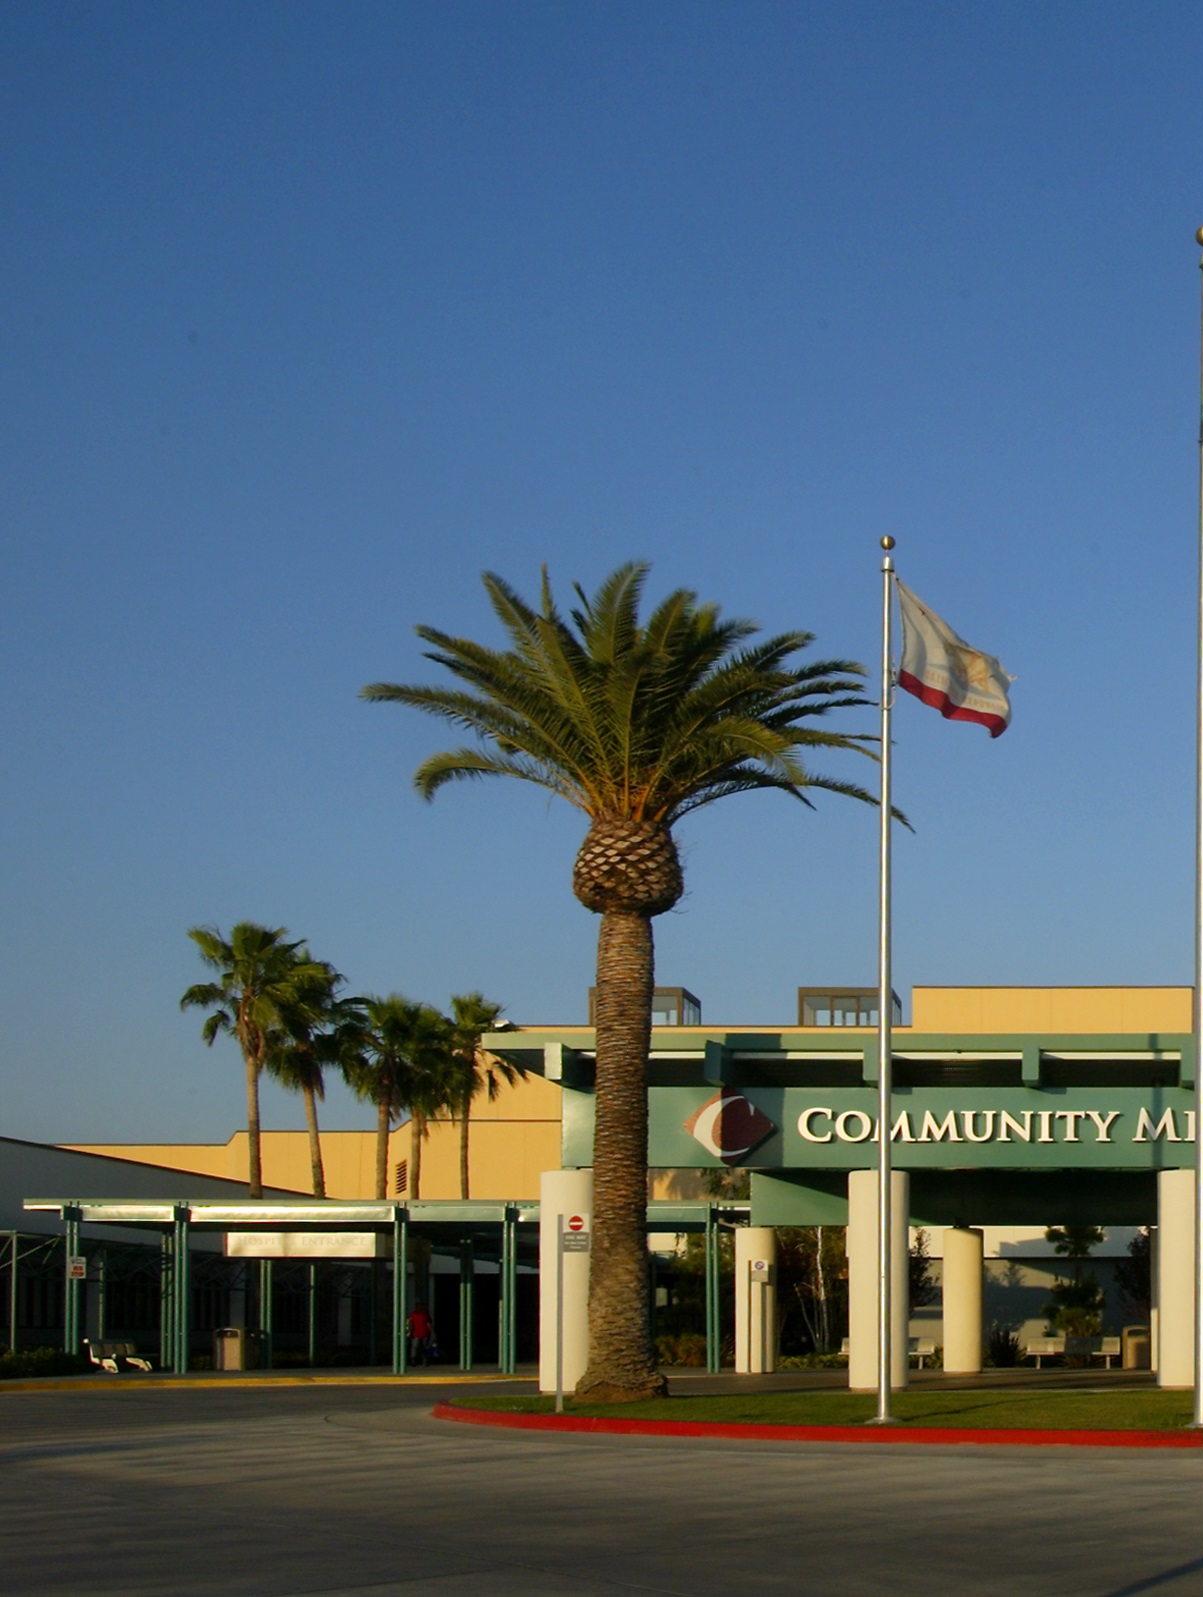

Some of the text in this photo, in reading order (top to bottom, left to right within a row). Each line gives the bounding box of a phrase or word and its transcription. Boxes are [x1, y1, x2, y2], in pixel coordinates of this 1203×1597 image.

[797, 1107, 1119, 1143] COMMUNITY
[238, 1236, 366, 1245] HOSPIT ENTRANCE
